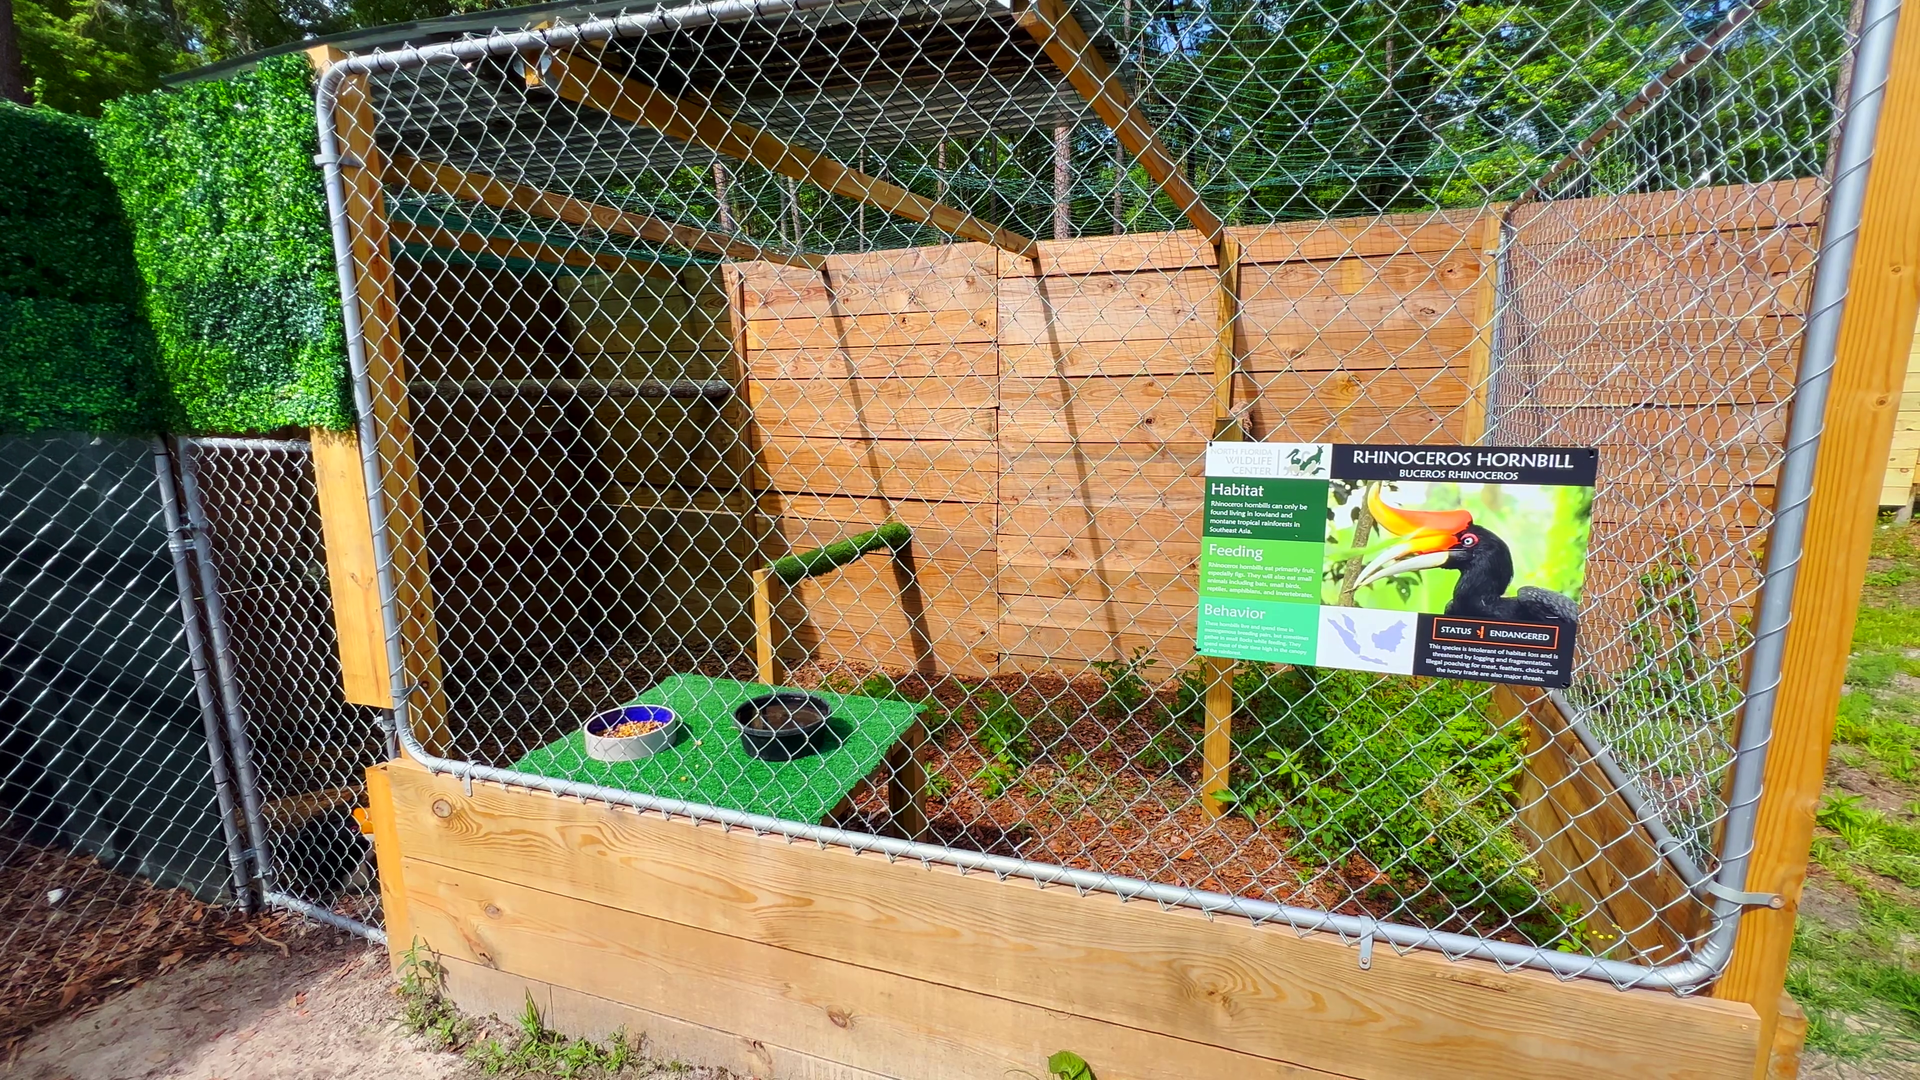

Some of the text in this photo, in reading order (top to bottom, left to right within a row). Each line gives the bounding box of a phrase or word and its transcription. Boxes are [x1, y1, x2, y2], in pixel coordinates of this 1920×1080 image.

[1226, 456, 1272, 465] WILDLIFE
[1353, 451, 1573, 468] RHINOCEROS HORNBILL
[1232, 467, 1271, 475] CENTER
[1399, 470, 1518, 480] BUCEROS RHINOCEROS
[1211, 483, 1264, 496] Habitat
[1209, 544, 1263, 561] Feeding
[1229, 579, 1254, 587] including
[1205, 604, 1265, 619] Behavior
[1441, 626, 1549, 640] STATUS ENDANGERED
[1468, 646, 1496, 654] intolerant
[1444, 660, 1470, 668] poaching
[1499, 664, 1524, 672] feathers,
[1473, 654, 1494, 662] logging
[1509, 657, 1552, 666] fragmentation.
[1504, 673, 1521, 681] major
[1523, 674, 1544, 682] threats.
